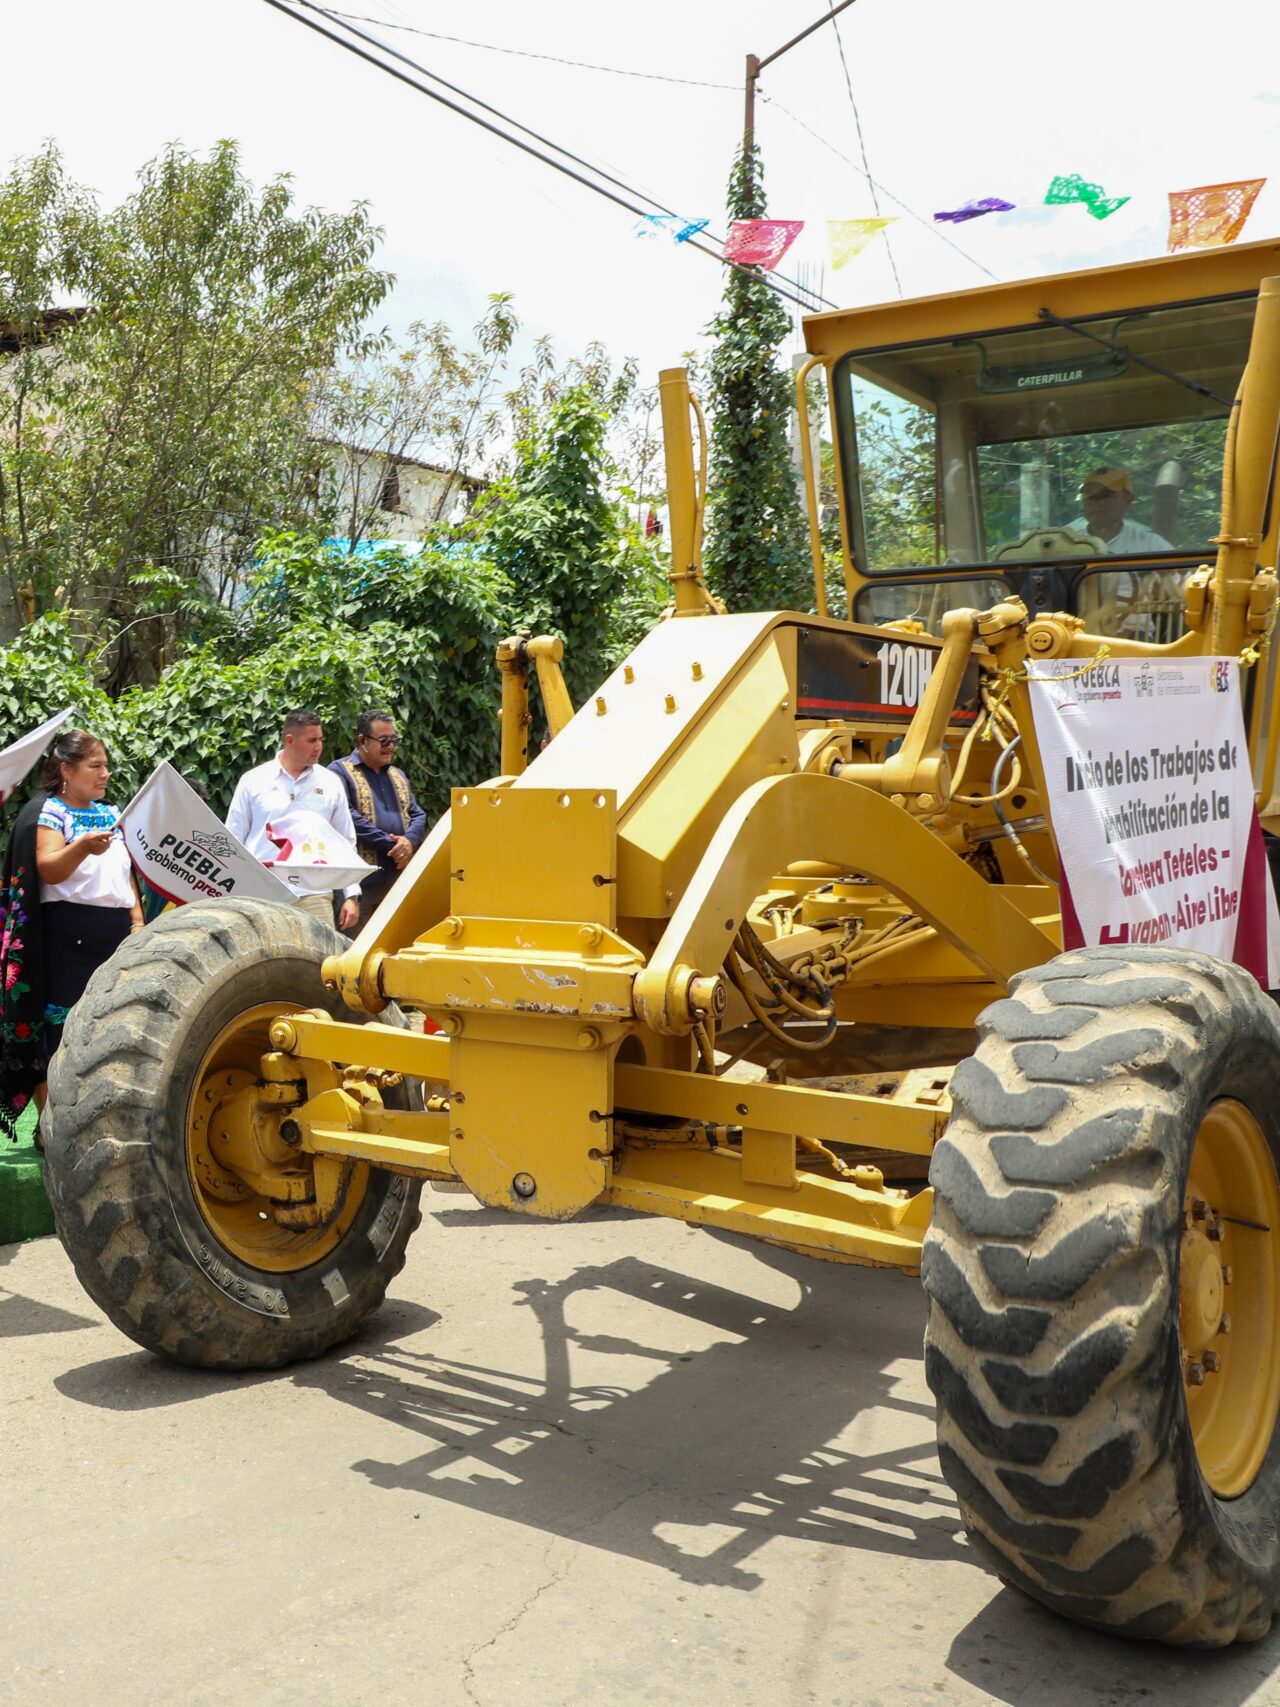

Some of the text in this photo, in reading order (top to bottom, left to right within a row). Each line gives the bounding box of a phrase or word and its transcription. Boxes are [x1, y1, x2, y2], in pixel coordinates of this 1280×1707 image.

[1017, 370, 1083, 388] CATERPILLAR
[877, 643, 933, 708] 120H
[1105, 751, 1123, 787] de
[1126, 750, 1149, 784] los
[1150, 739, 1215, 786] Trabajos
[1190, 792, 1209, 823] de
[1212, 790, 1230, 822] la
[136, 828, 149, 851] Un
[144, 848, 196, 884] gobierno
[159, 833, 236, 893] PUEBLA
[1164, 842, 1219, 883] Teteles
[1176, 893, 1207, 933] Aire
